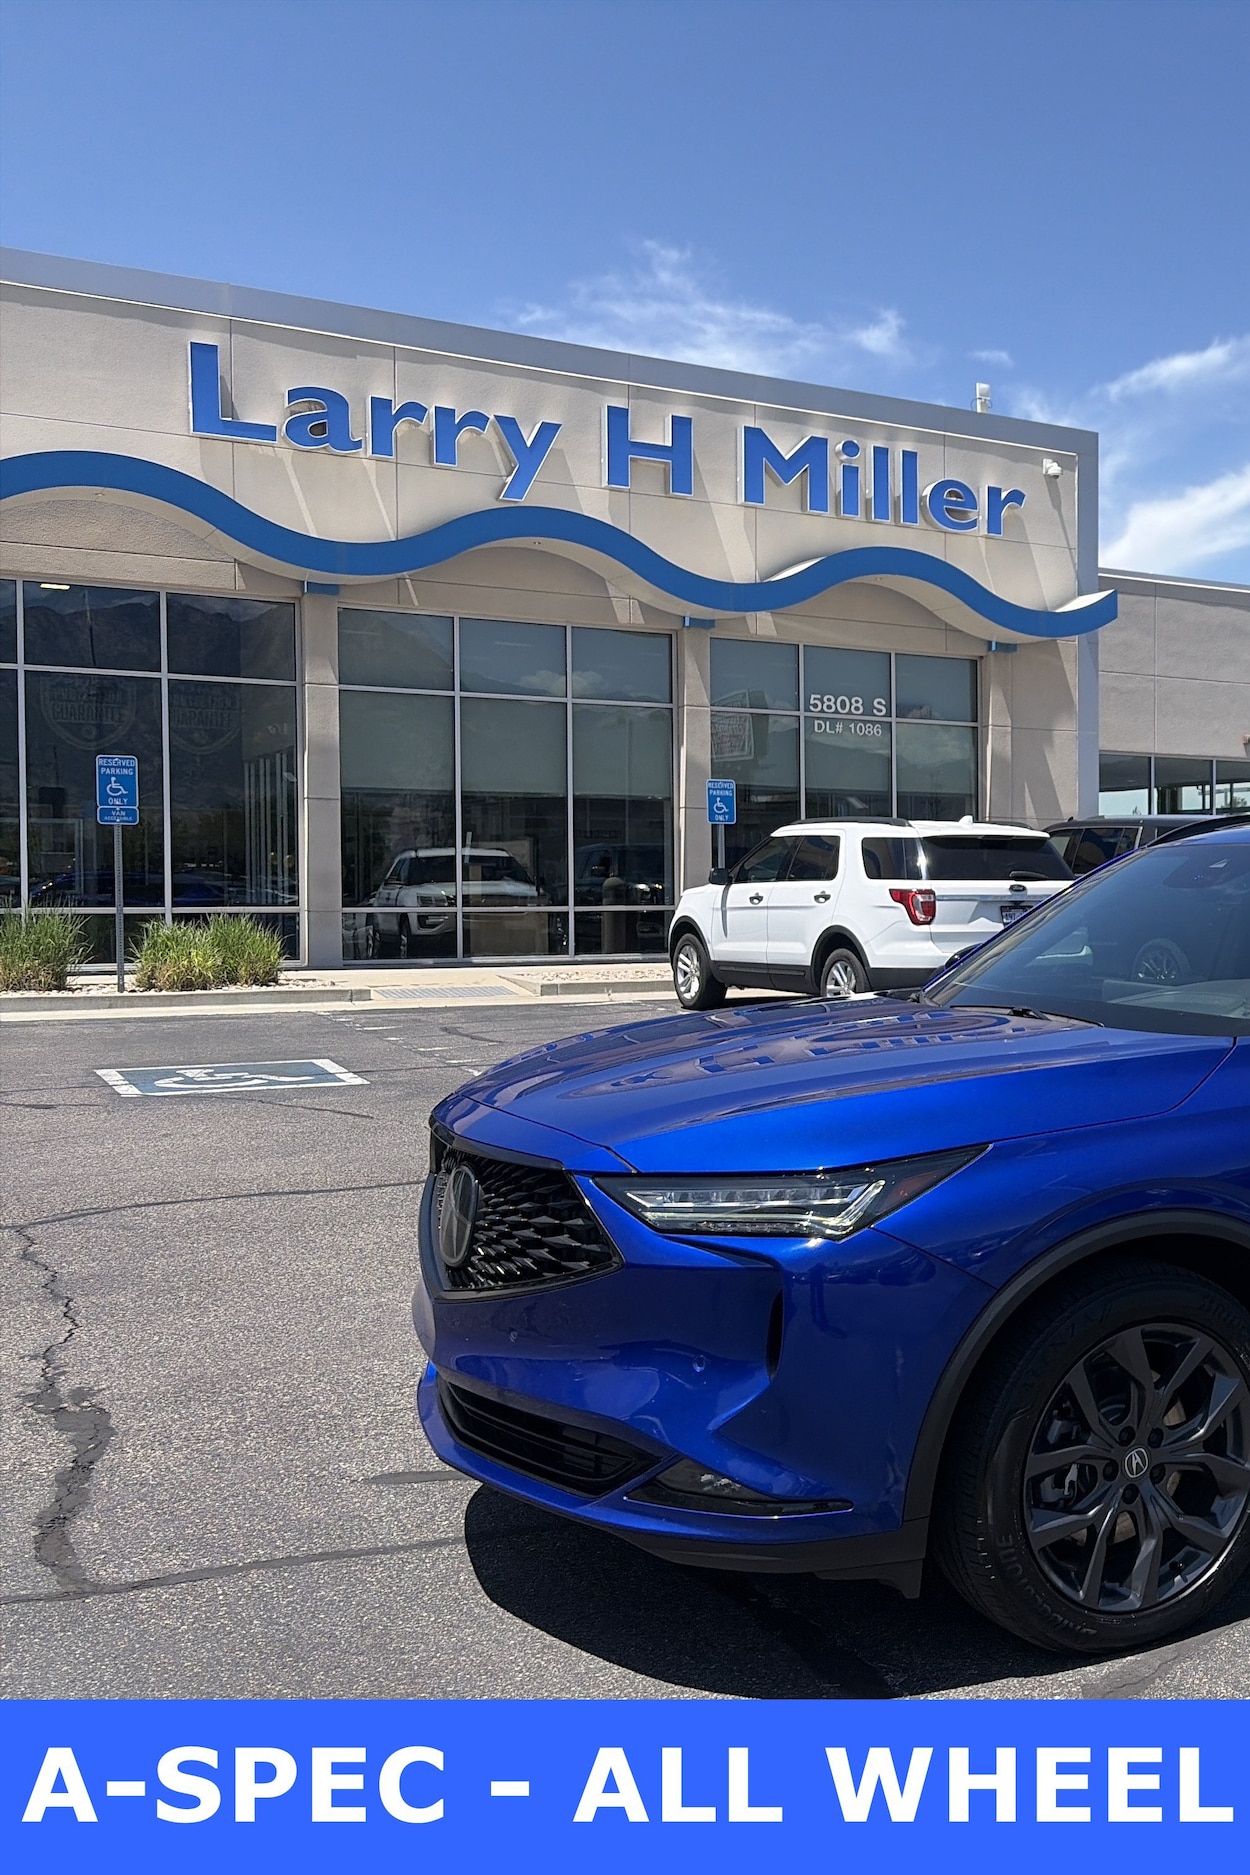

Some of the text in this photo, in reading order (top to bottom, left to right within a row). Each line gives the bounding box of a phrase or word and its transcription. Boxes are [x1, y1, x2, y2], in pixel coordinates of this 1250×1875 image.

[187, 340, 1026, 536] Larry H Miller
[809, 694, 886, 716] 5808 S
[814, 719, 882, 737] DL# 1086
[98, 758, 136, 767] RESERVED
[100, 767, 134, 775] PARKING
[709, 789, 733, 797] PARKING
[107, 797, 128, 805] ONLY
